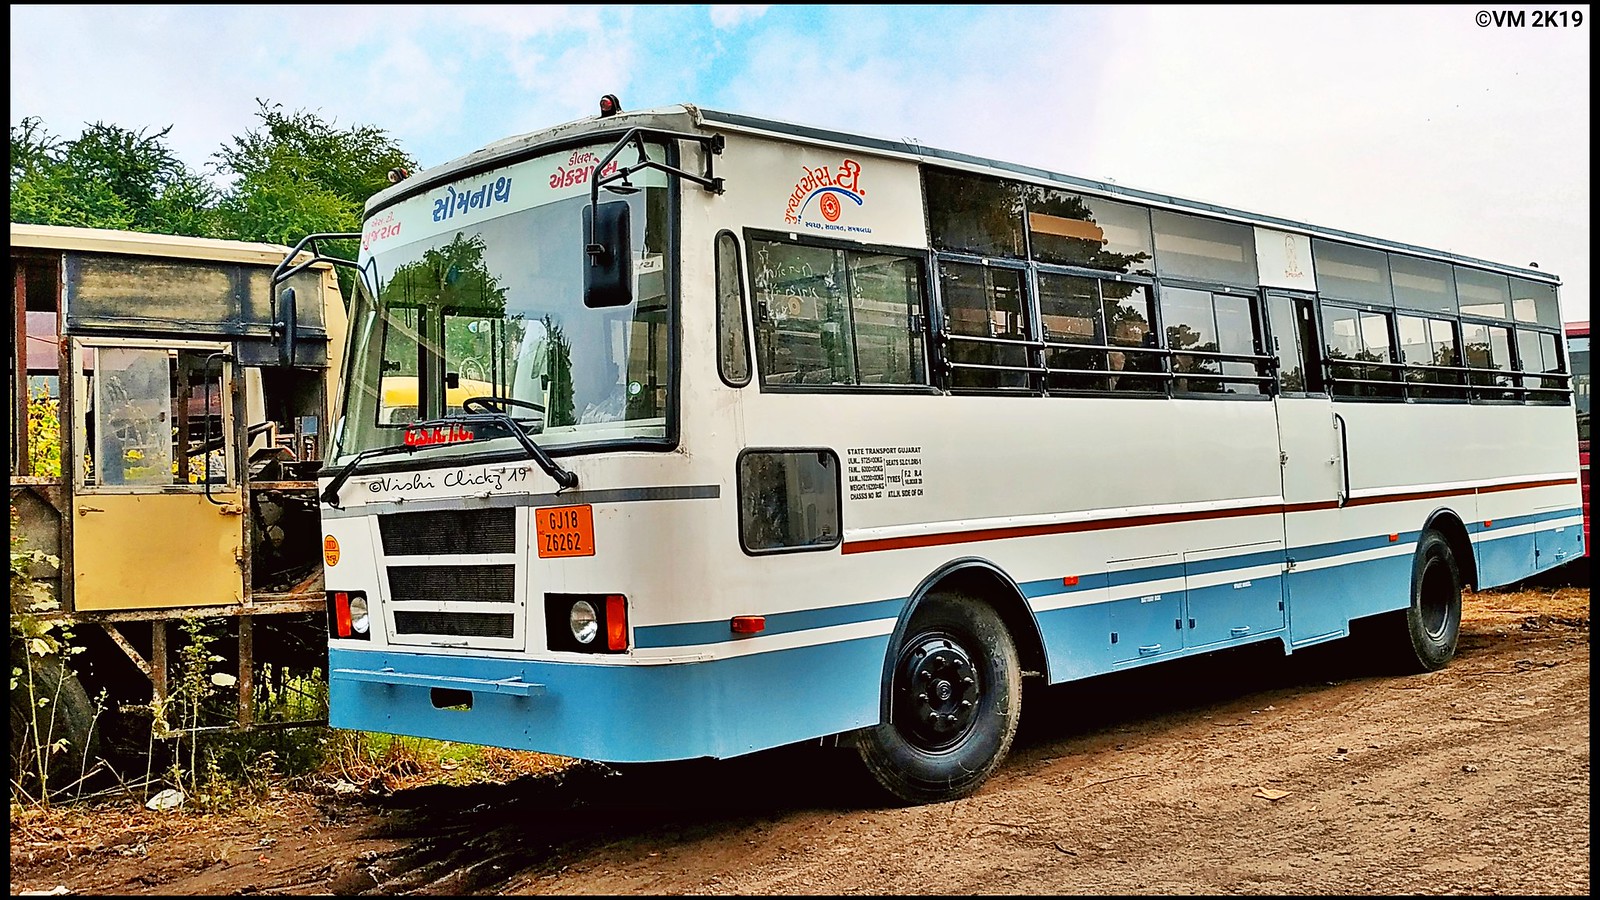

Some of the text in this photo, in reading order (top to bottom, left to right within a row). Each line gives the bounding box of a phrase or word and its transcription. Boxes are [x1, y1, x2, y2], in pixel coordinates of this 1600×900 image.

[433, 176, 512, 222] સોમનાથ
[865, 447, 896, 455] TRANSPORT
[887, 475, 901, 483] TYRES
[549, 510, 578, 530] GJ18
[545, 532, 582, 552] Z6262
